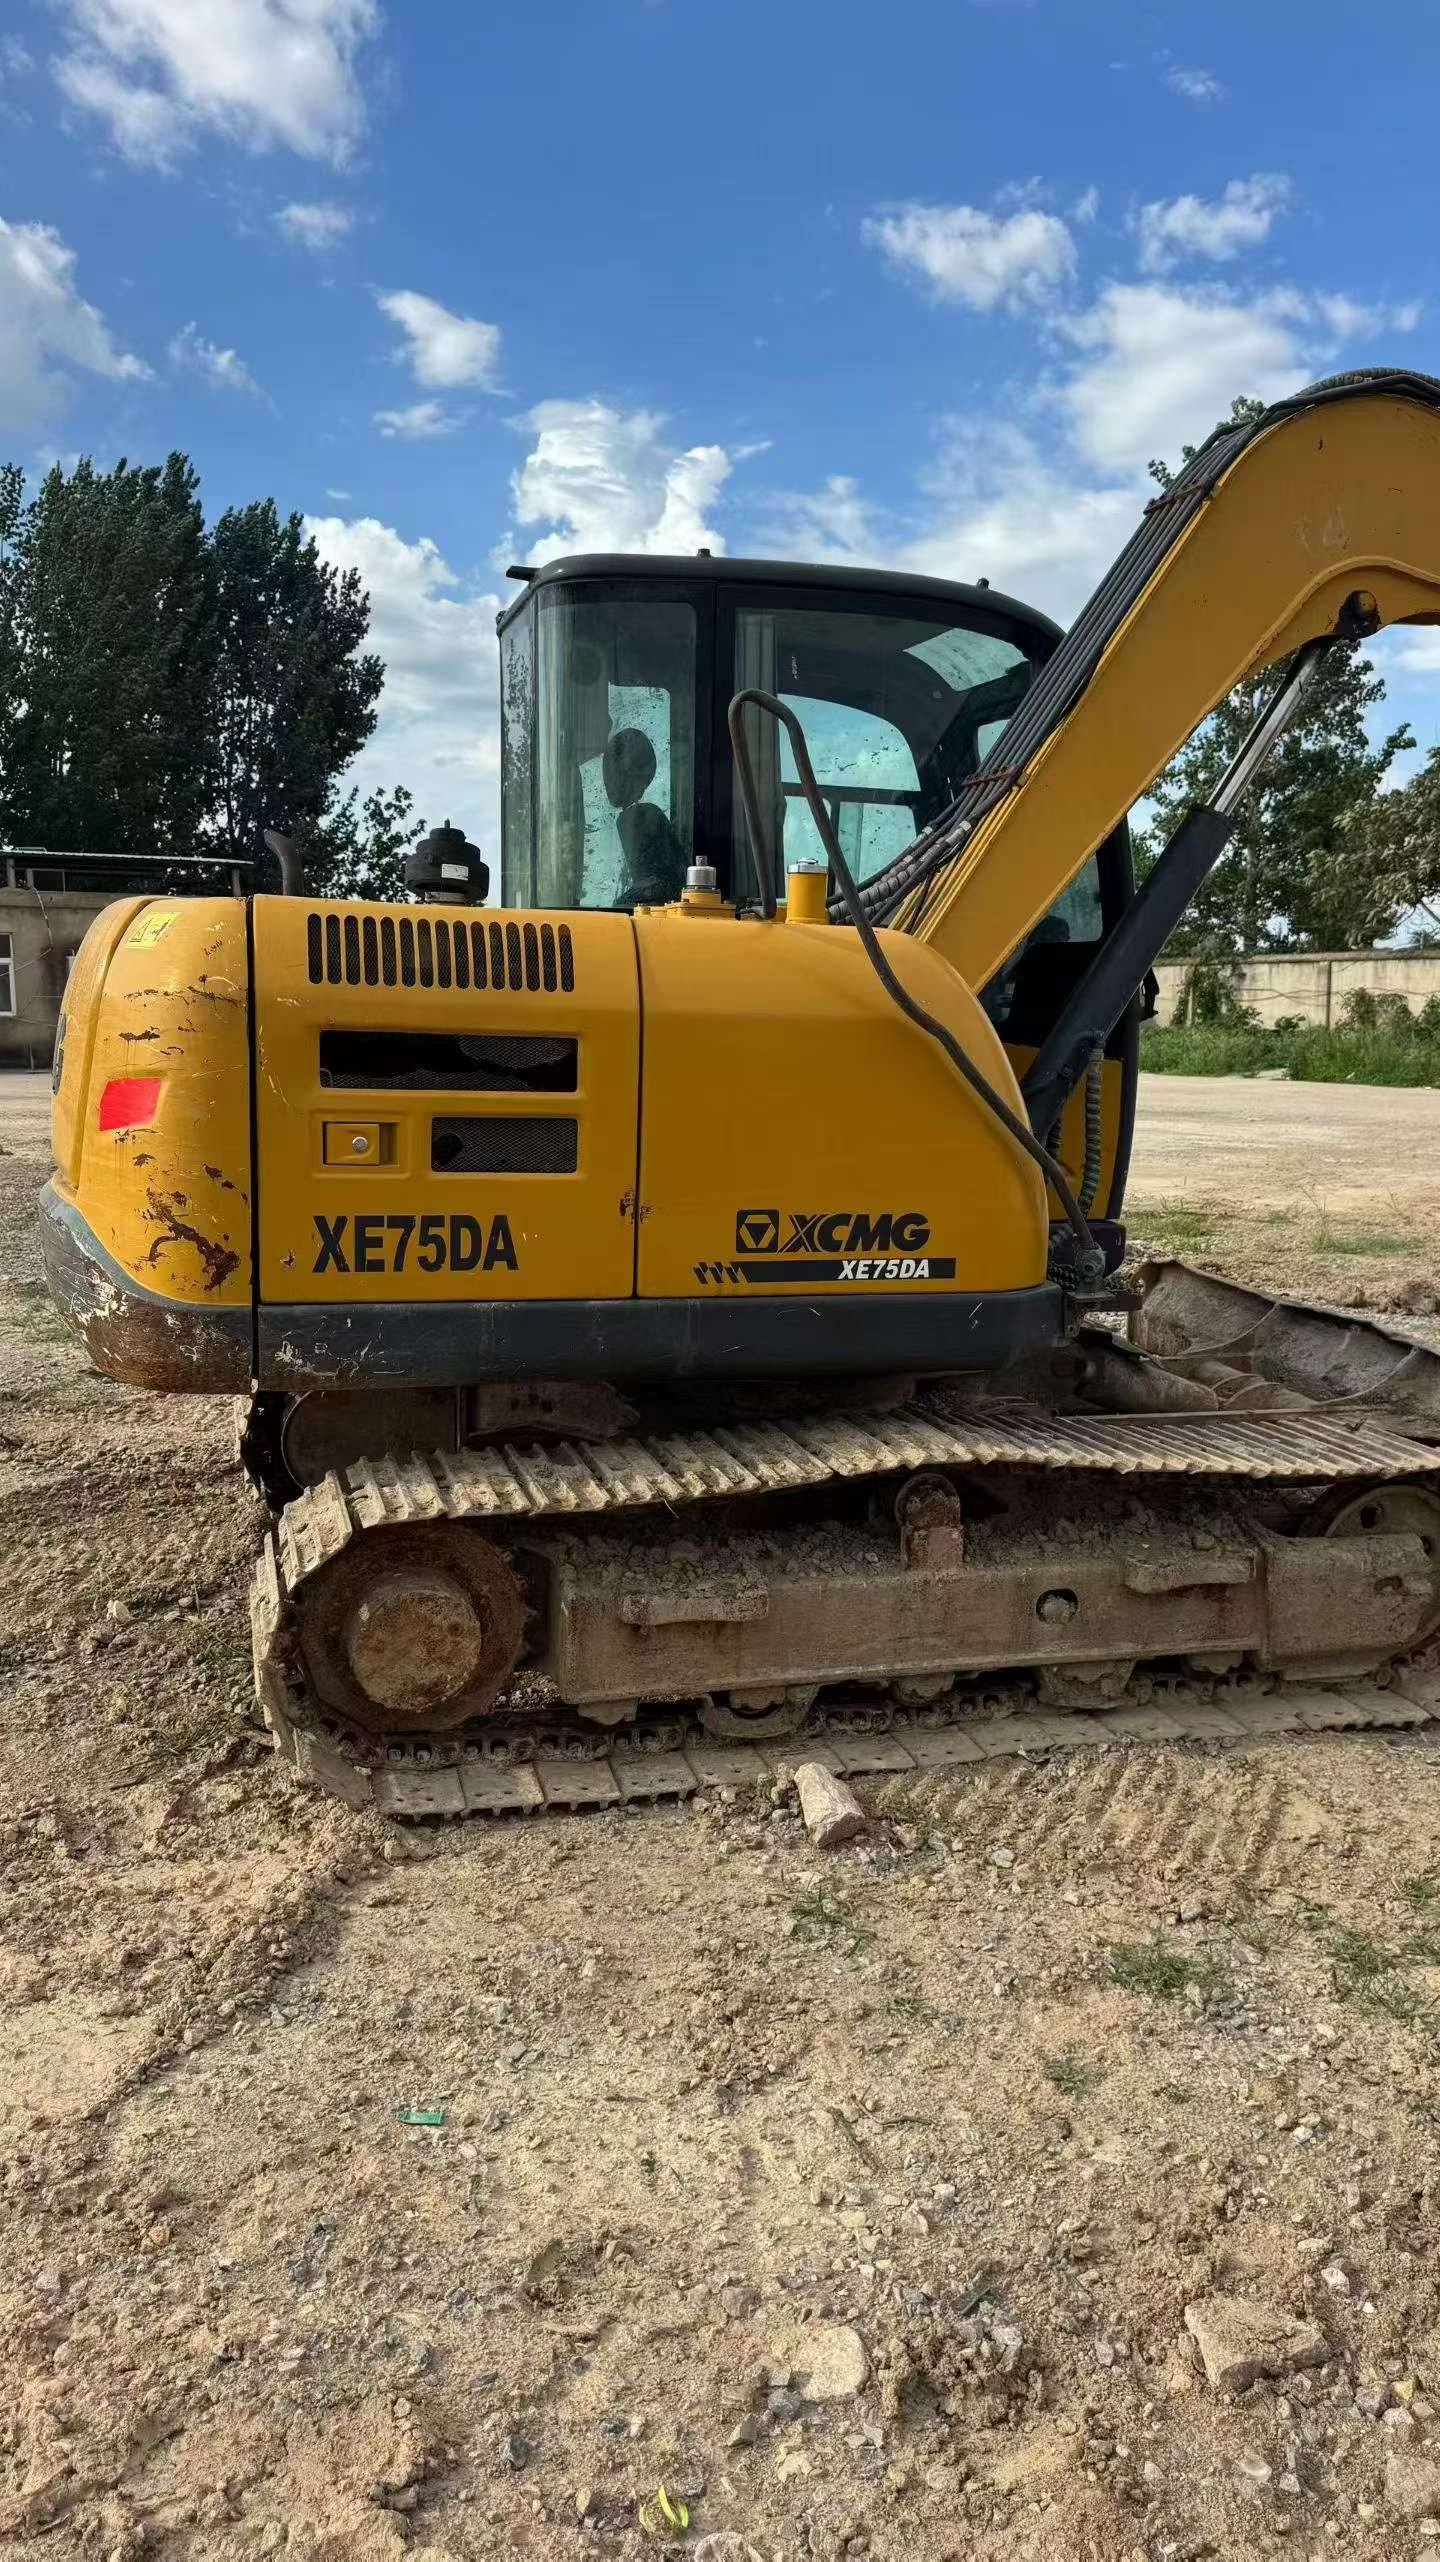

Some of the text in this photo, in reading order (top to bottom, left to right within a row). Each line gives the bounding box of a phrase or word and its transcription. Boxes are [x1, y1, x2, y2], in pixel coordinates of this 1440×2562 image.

[312, 1215, 519, 1273] XE75DA
[777, 1213, 931, 1253] XCMG
[837, 1259, 930, 1281] XE75DA
